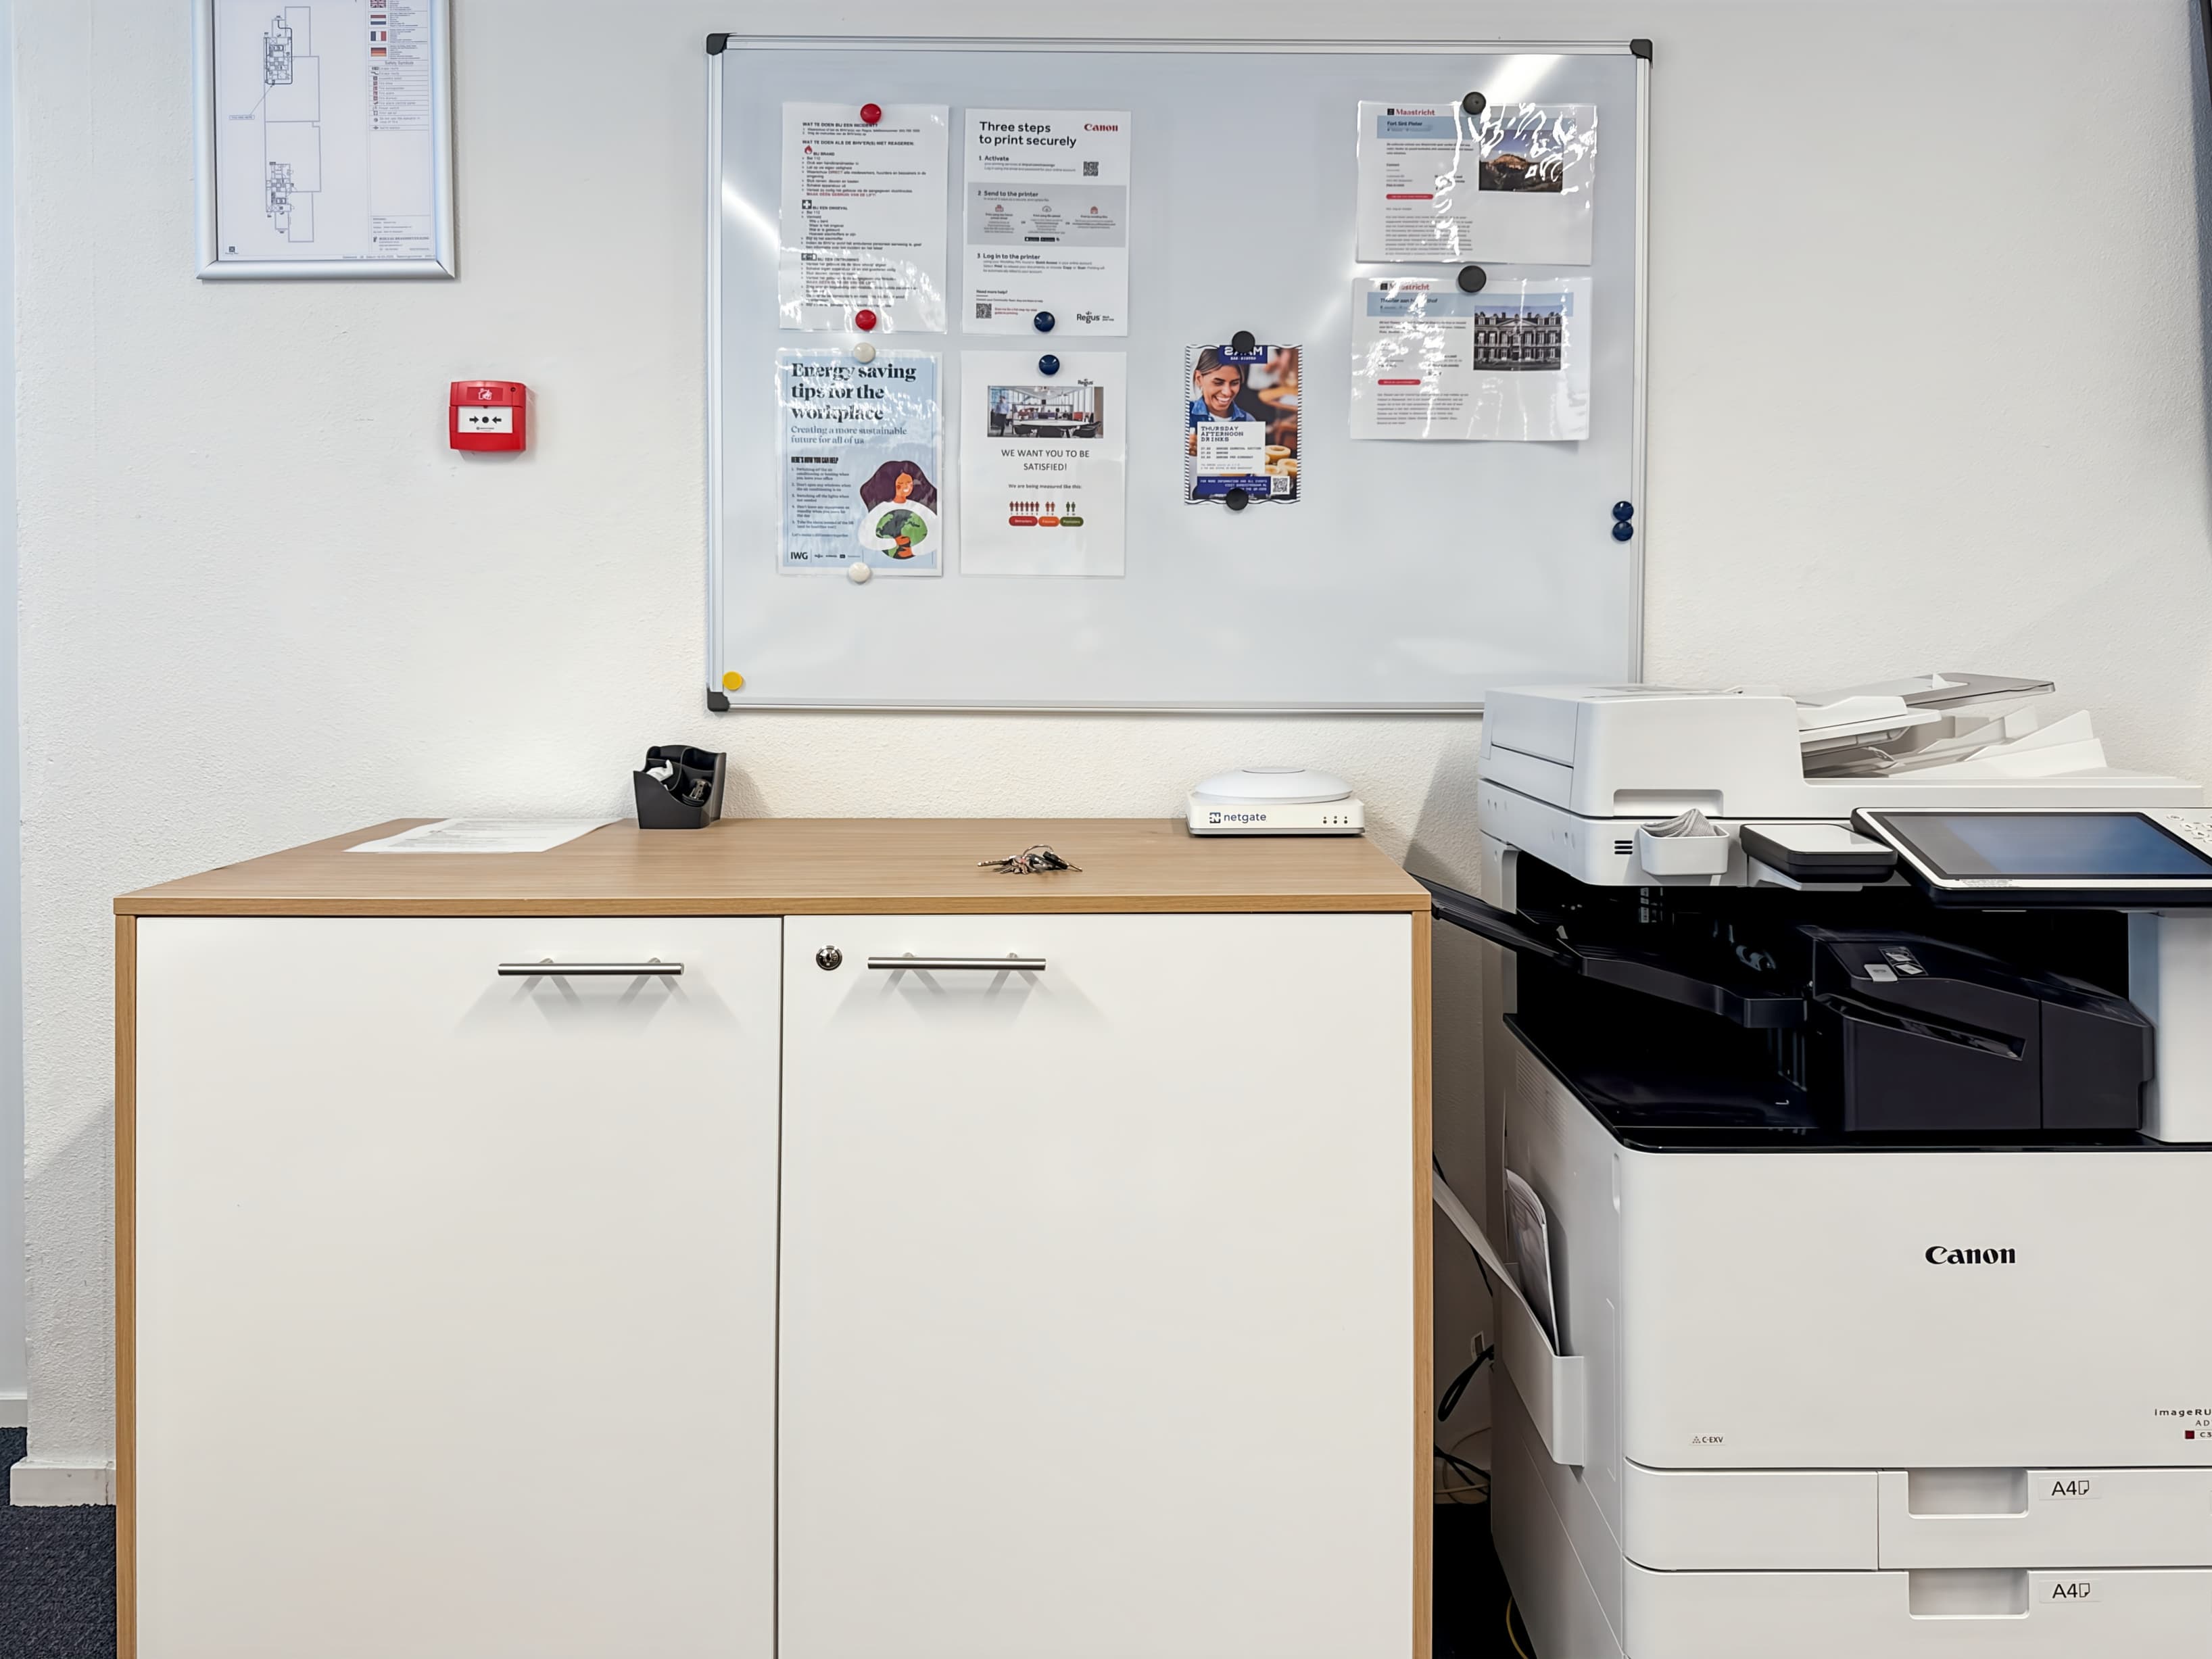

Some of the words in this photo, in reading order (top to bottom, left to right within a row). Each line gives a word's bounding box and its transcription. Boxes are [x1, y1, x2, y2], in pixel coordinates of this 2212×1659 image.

[980, 122, 1015, 131] Three
[1018, 122, 1051, 135] steps
[1084, 123, 1118, 131] Canon
[980, 135, 992, 144] to
[994, 135, 1024, 146] print
[1026, 136, 1077, 148] securely
[1076, 313, 1100, 324] Regus
[791, 363, 855, 381] Energy
[858, 364, 917, 382] saving
[791, 383, 825, 401] tips
[829, 383, 853, 398] for
[857, 385, 884, 399] the
[791, 405, 884, 423] workplace
[791, 426, 827, 435] Creating
[859, 427, 907, 435] sustainable
[791, 435, 818, 443] future
[819, 435, 831, 443] for
[844, 436, 853, 444] of
[791, 552, 808, 560] IWG
[1224, 813, 1266, 823] netgate
[1925, 1246, 2015, 1264] Canon
[2052, 1481, 2077, 1496] A4
[2052, 1583, 2077, 1599] A4
